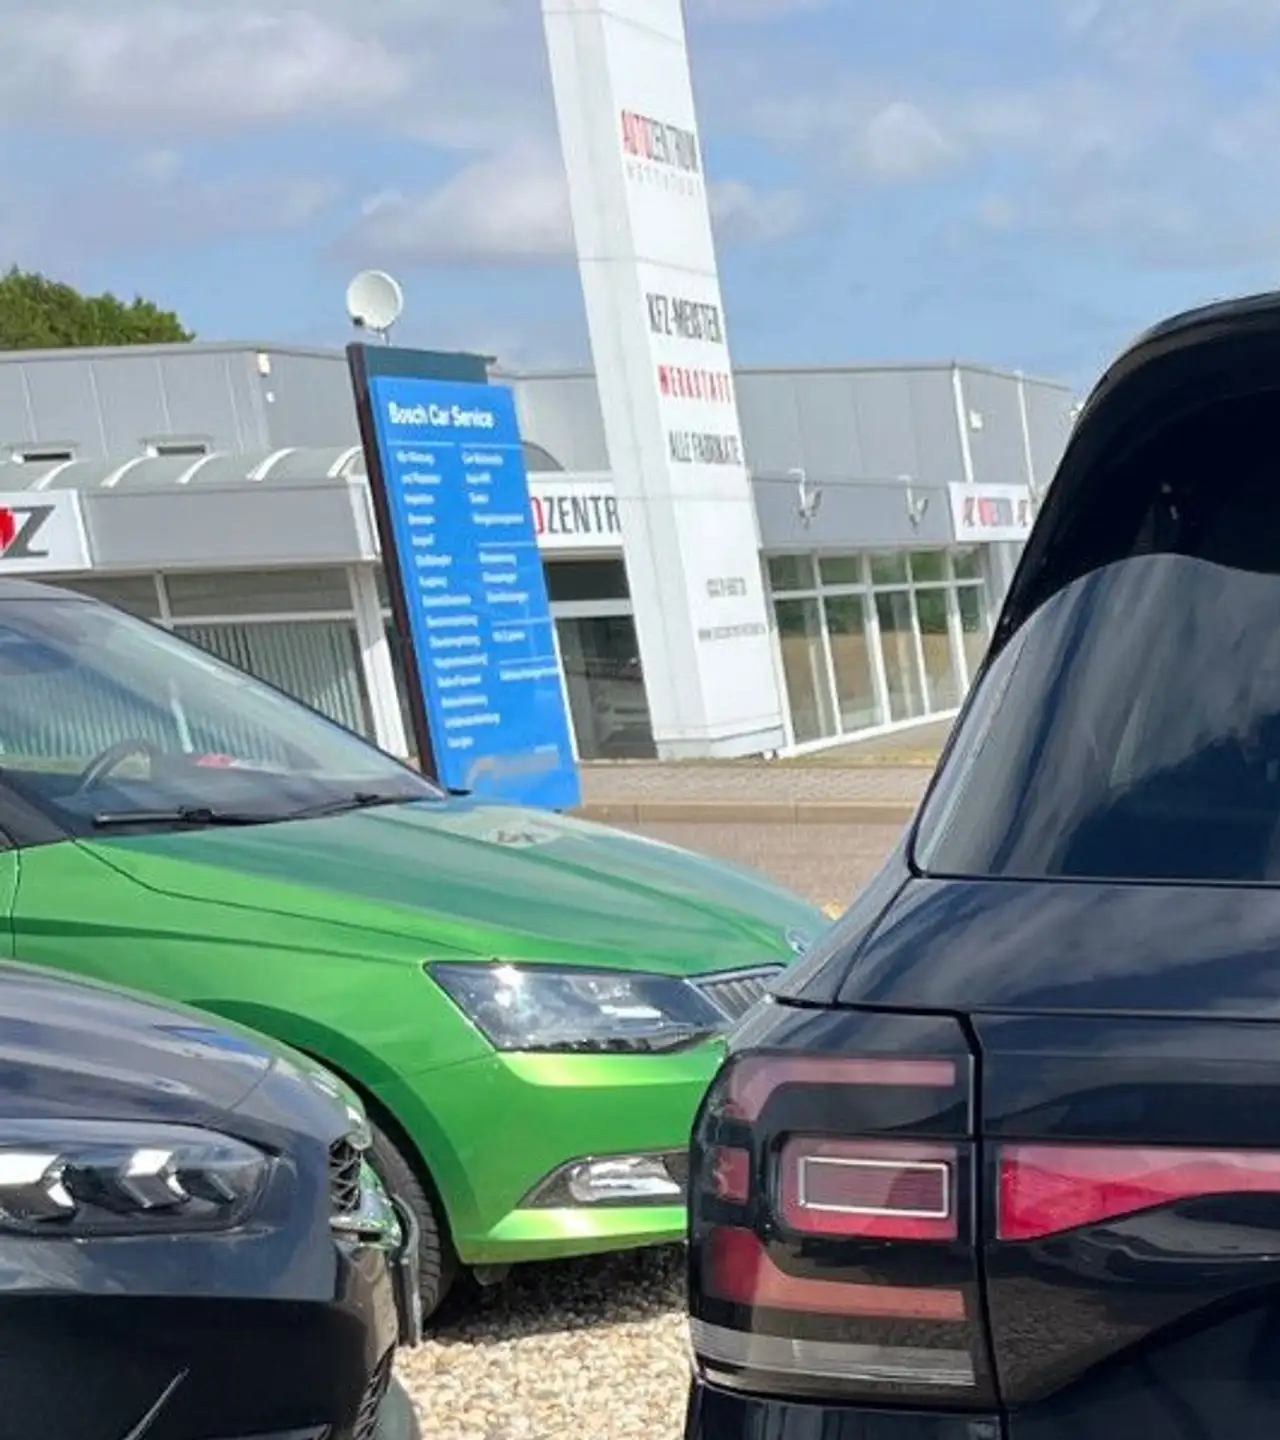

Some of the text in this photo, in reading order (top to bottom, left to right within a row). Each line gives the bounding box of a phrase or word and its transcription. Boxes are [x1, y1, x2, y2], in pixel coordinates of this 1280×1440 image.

[388, 401, 495, 429] Bosch Car Service
